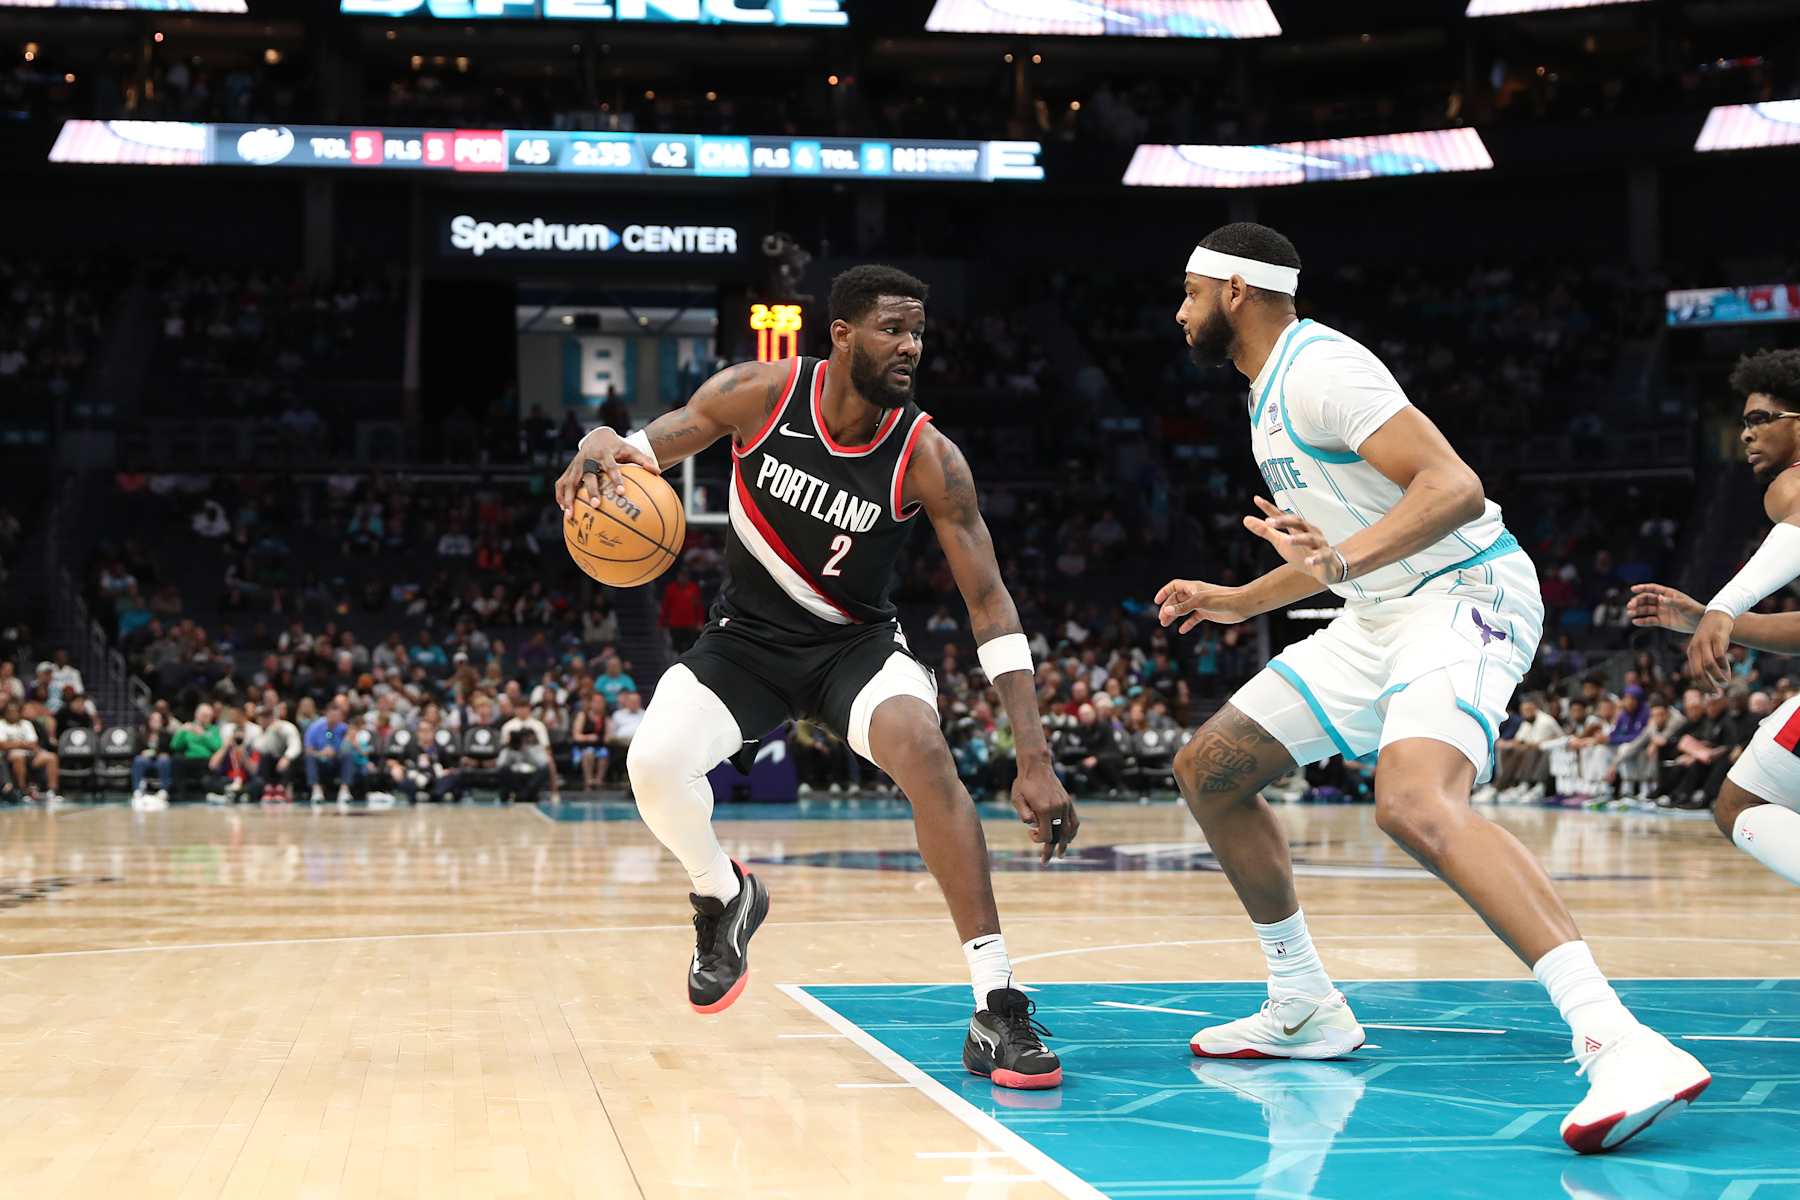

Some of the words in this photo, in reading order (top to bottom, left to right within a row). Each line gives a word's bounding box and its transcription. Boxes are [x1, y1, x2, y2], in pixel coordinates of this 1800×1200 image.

[454, 138, 503, 163] POR
[514, 139, 550, 165] 45
[572, 141, 632, 166] 2:35
[652, 142, 687, 168] 42
[451, 215, 610, 256] Spectrum
[622, 225, 738, 253] CENTER
[751, 304, 802, 331] 2:35
[756, 452, 882, 533] PORTLAND
[822, 533, 852, 577] 2
